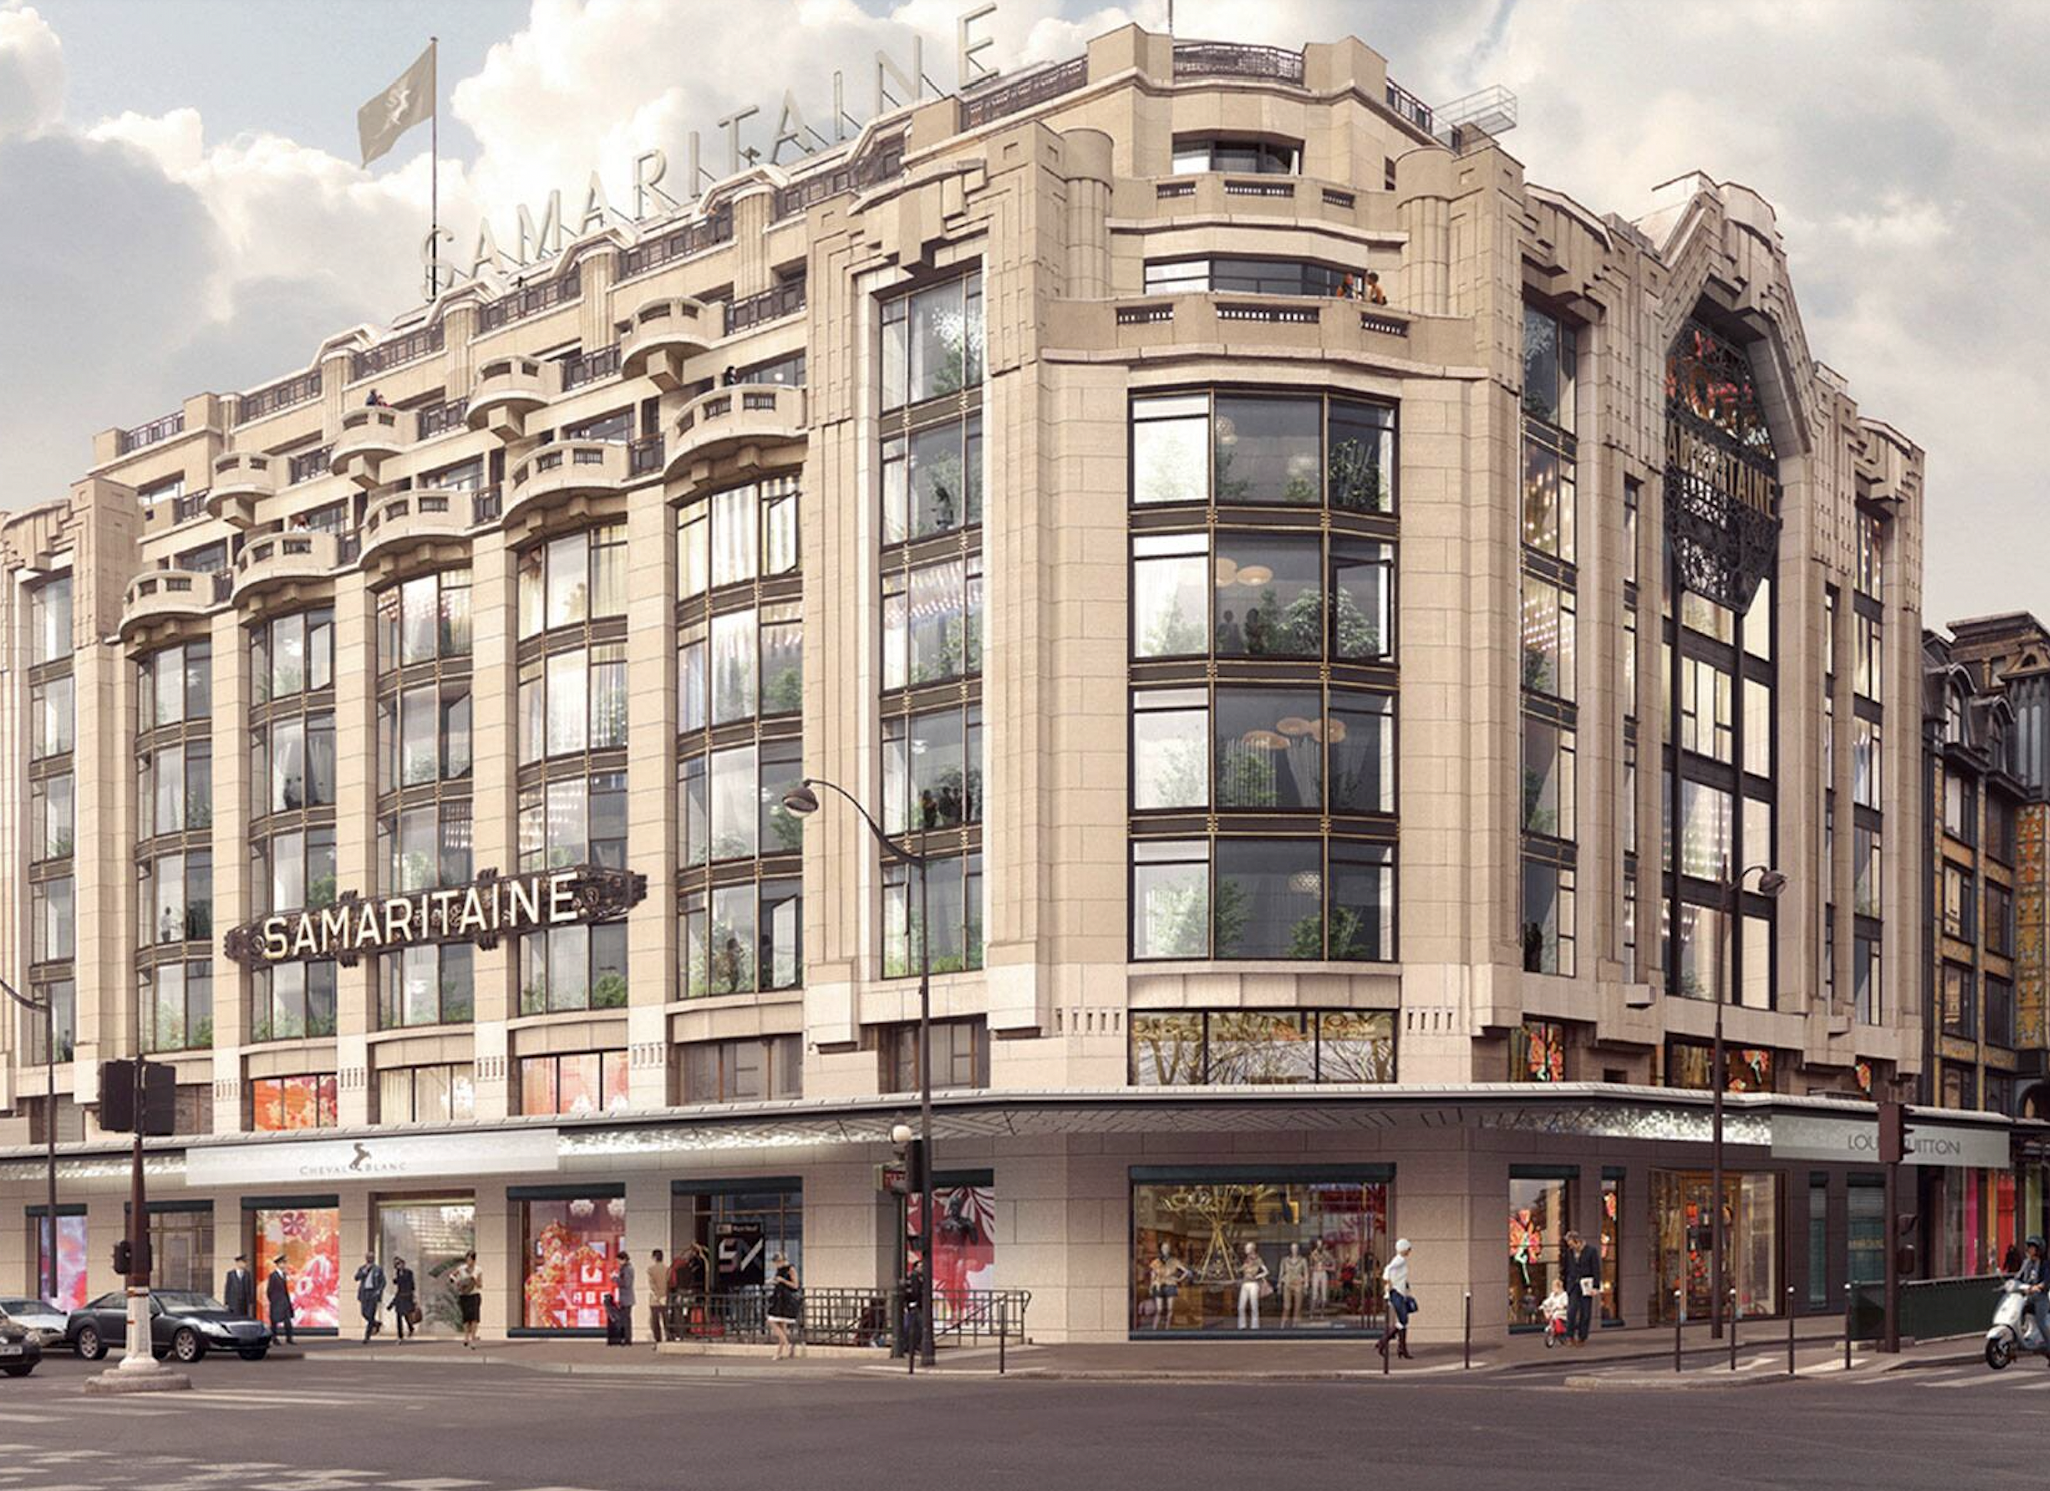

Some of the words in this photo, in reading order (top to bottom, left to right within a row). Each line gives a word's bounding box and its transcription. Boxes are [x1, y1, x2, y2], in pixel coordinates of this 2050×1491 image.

[420, 2, 1000, 302] SAMARITAINE
[262, 871, 579, 959] SAMARITAINE
[299, 1165, 347, 1176] CHEVAL
[366, 1162, 408, 1172] BLANC
[1847, 1133, 1876, 1151] LOU
[1904, 1139, 1961, 1155] UITTON
